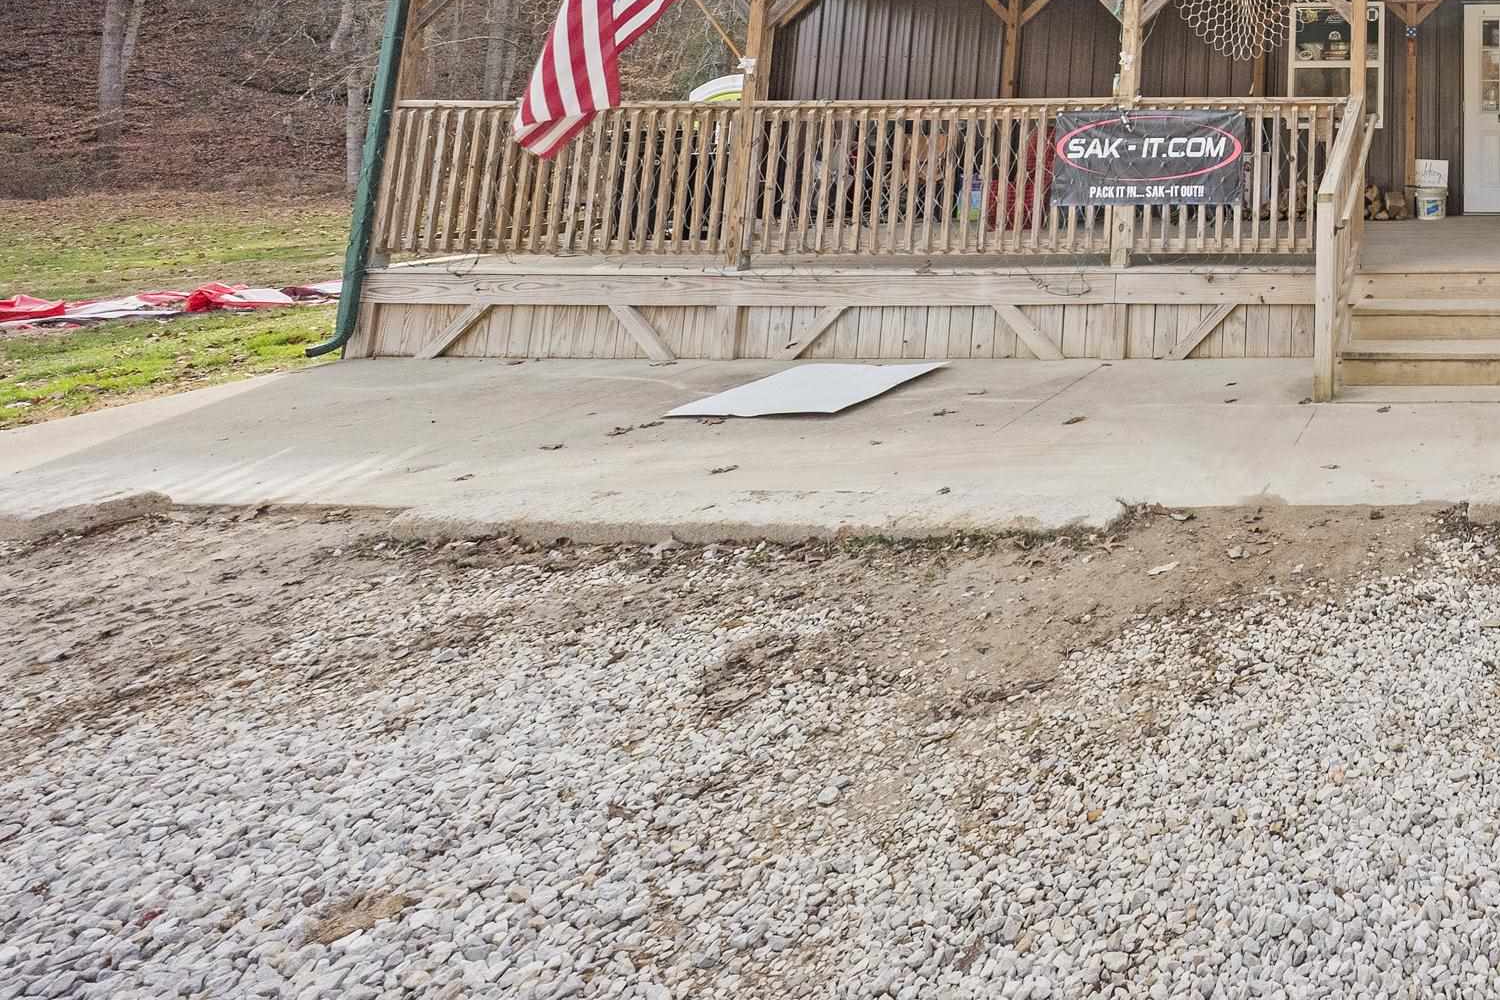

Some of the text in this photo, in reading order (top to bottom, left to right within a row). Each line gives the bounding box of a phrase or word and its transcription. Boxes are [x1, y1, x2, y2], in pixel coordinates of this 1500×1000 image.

[1089, 186, 1115, 198] PACK
[1115, 186, 1125, 198] IT
[1146, 185, 1179, 198] SAK-IT
[1180, 185, 1205, 197] OUT!!
